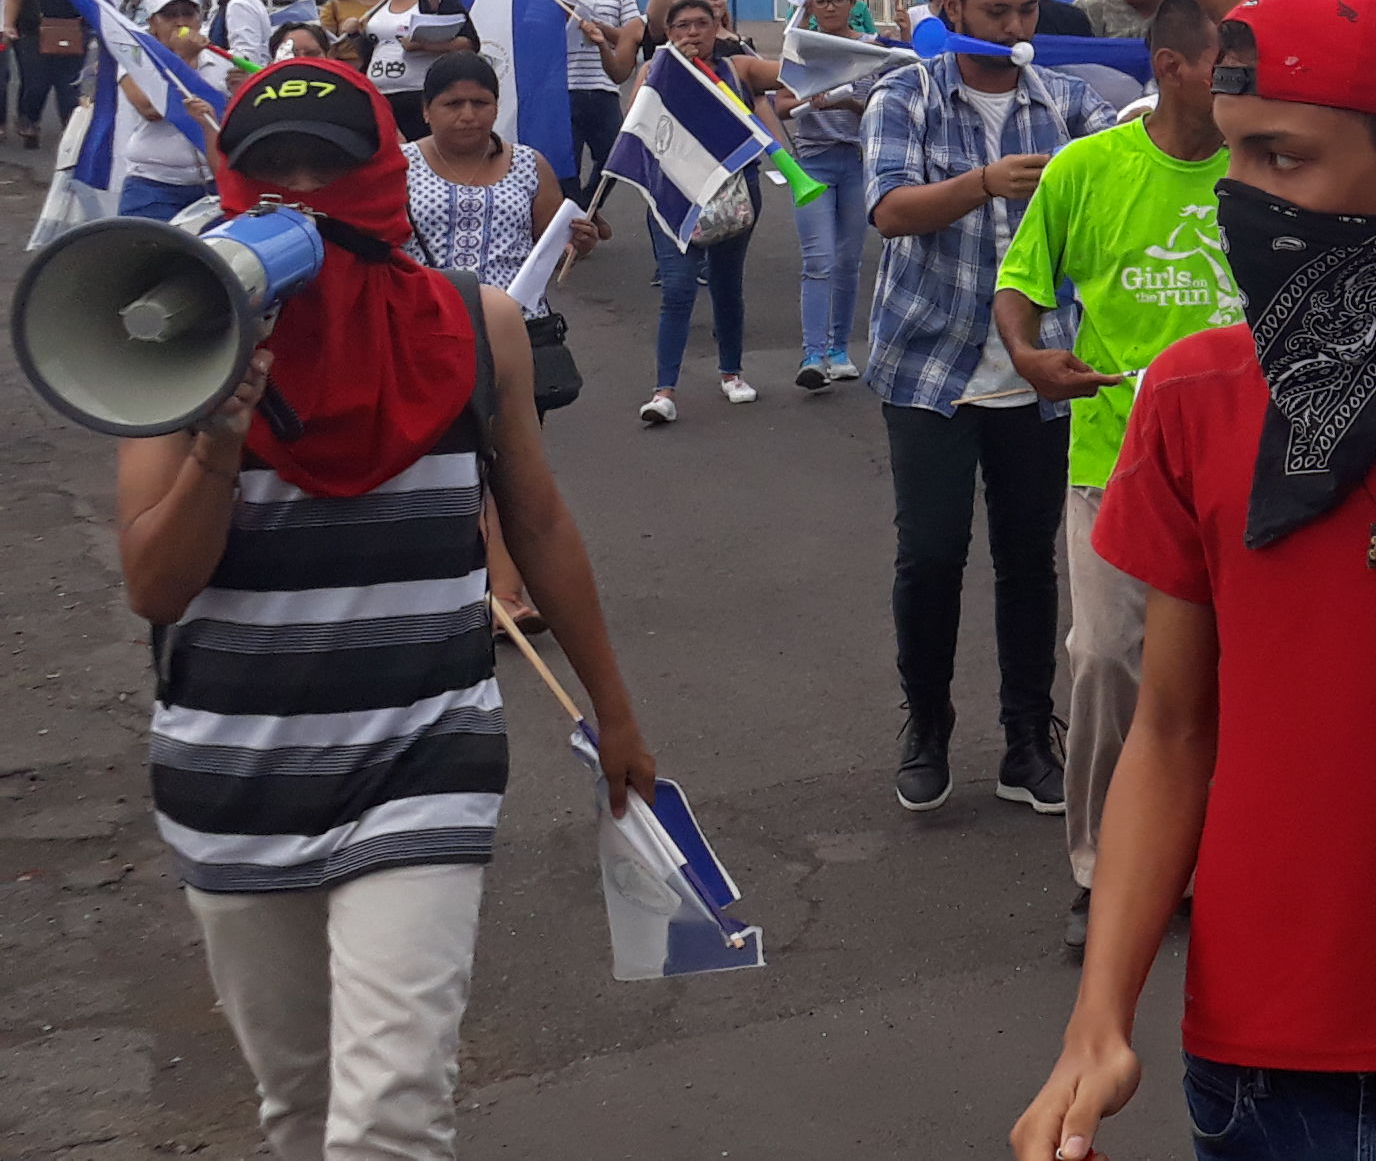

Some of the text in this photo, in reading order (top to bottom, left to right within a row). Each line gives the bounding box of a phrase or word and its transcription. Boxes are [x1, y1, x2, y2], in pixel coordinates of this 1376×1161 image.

[1121, 266, 1208, 290] Girls on
[1136, 289, 1211, 307] the run
